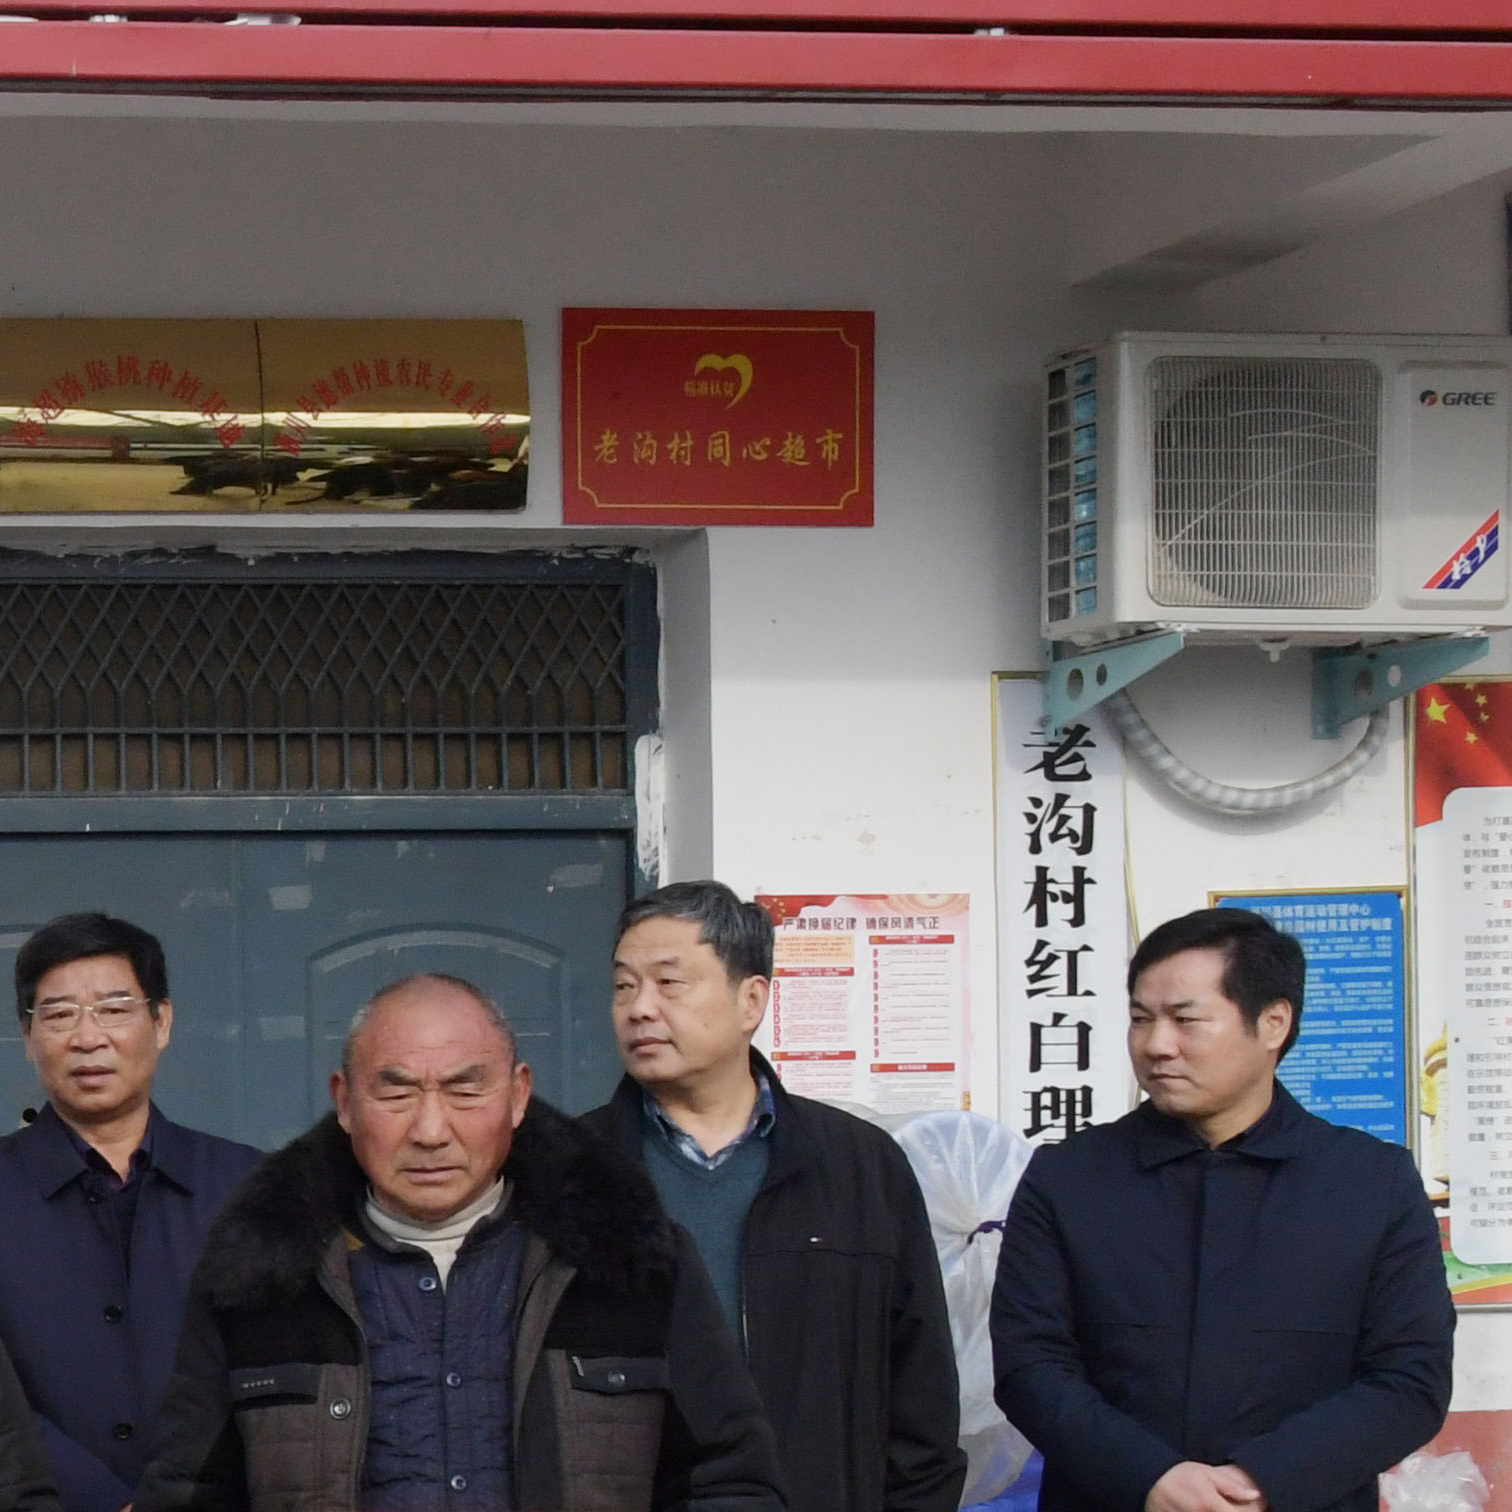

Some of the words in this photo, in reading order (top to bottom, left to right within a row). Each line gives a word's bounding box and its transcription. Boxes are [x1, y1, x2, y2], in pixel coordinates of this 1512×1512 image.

[1442, 391, 1496, 406] GREE
[593, 428, 844, 471] 老沟村同心超市
[1022, 723, 1098, 1145] 老沟村红白理
